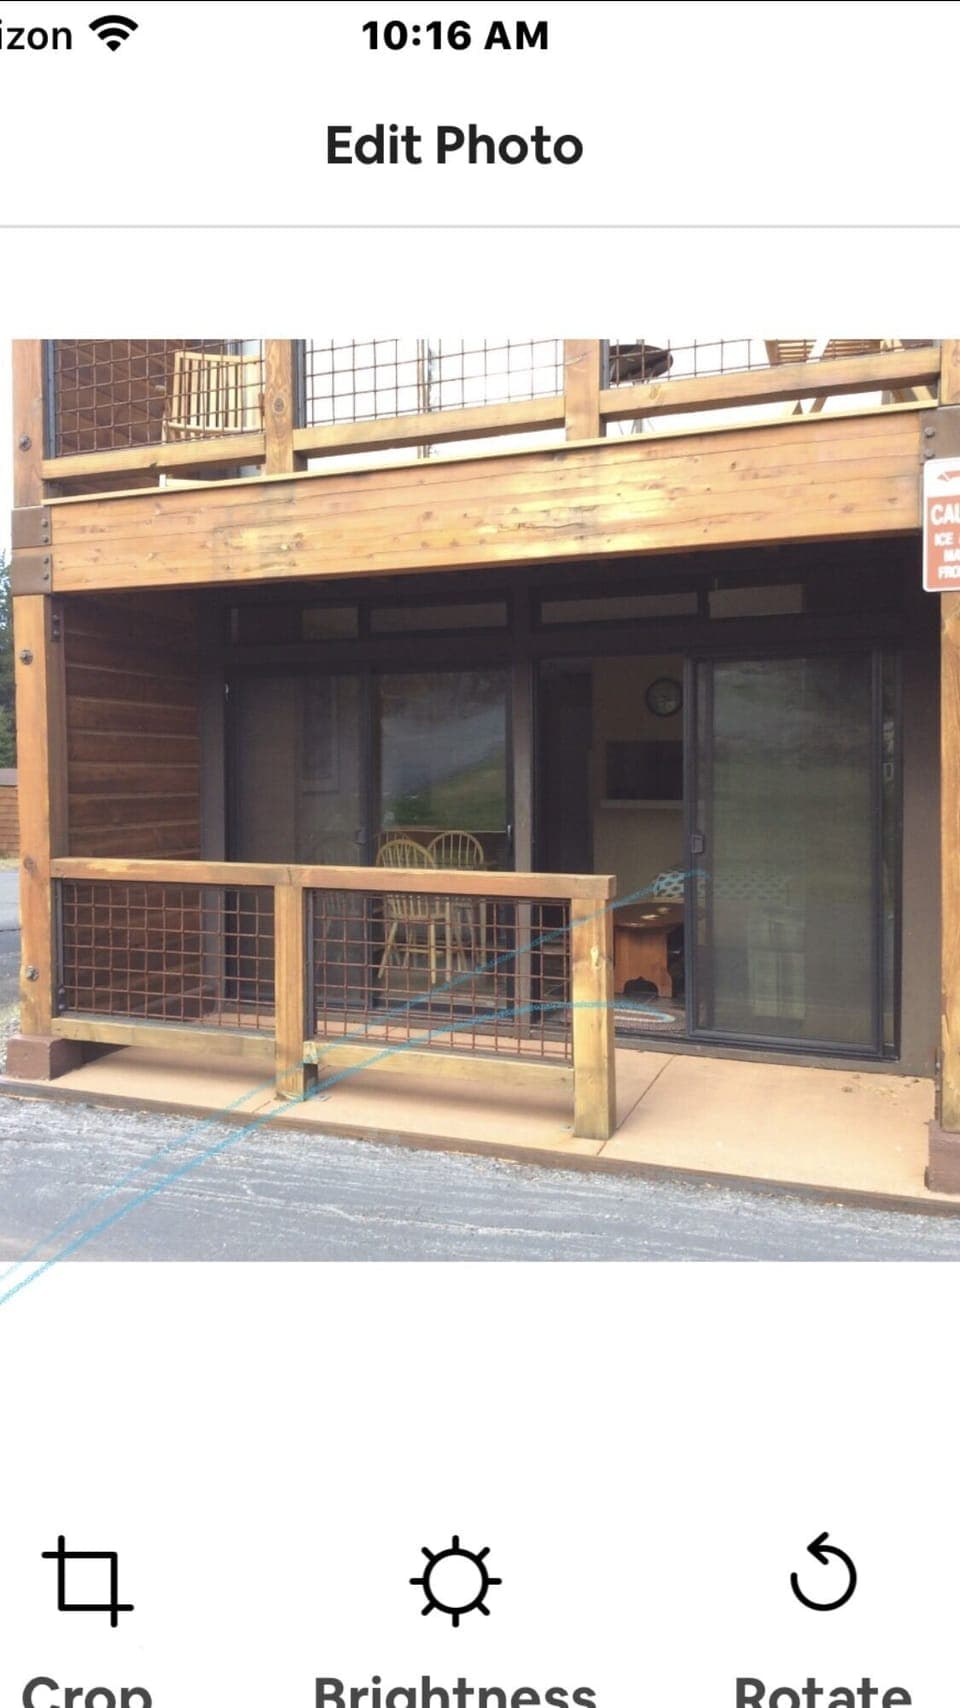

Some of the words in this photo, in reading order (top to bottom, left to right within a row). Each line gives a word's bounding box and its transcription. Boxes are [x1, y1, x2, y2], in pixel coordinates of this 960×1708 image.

[362, 20, 472, 51] 10:16
[483, 20, 549, 51] AM
[326, 123, 423, 165] Edit
[437, 123, 584, 165] Photo
[934, 532, 954, 546] ICE
[736, 1676, 913, 1708] Rotate
